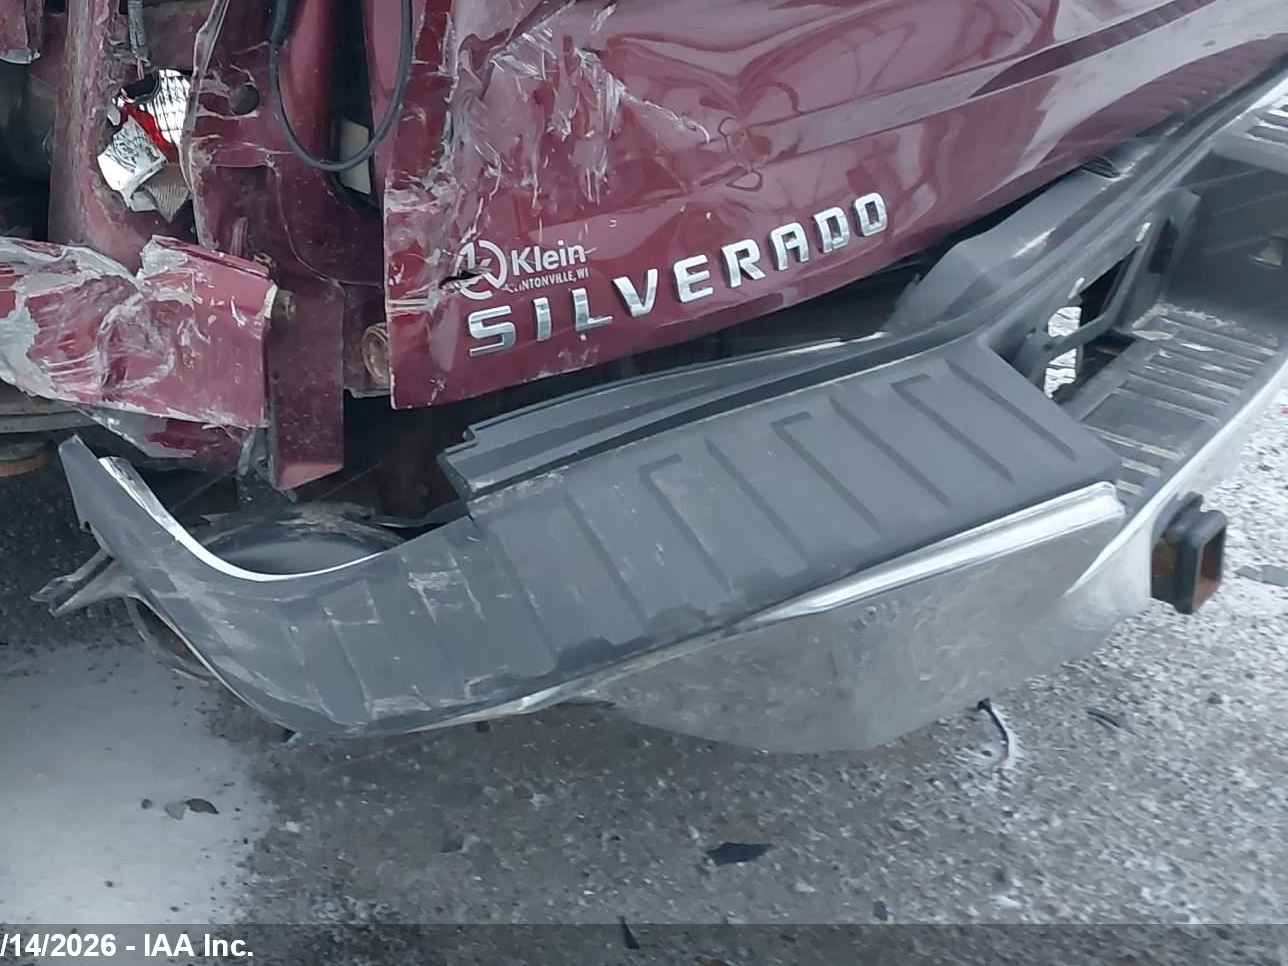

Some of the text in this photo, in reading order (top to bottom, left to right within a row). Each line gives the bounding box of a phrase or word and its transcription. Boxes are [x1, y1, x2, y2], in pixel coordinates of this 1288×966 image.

[467, 192, 889, 357] SILVERADO
[511, 240, 587, 276] Klein
[576, 267, 589, 279] WI
